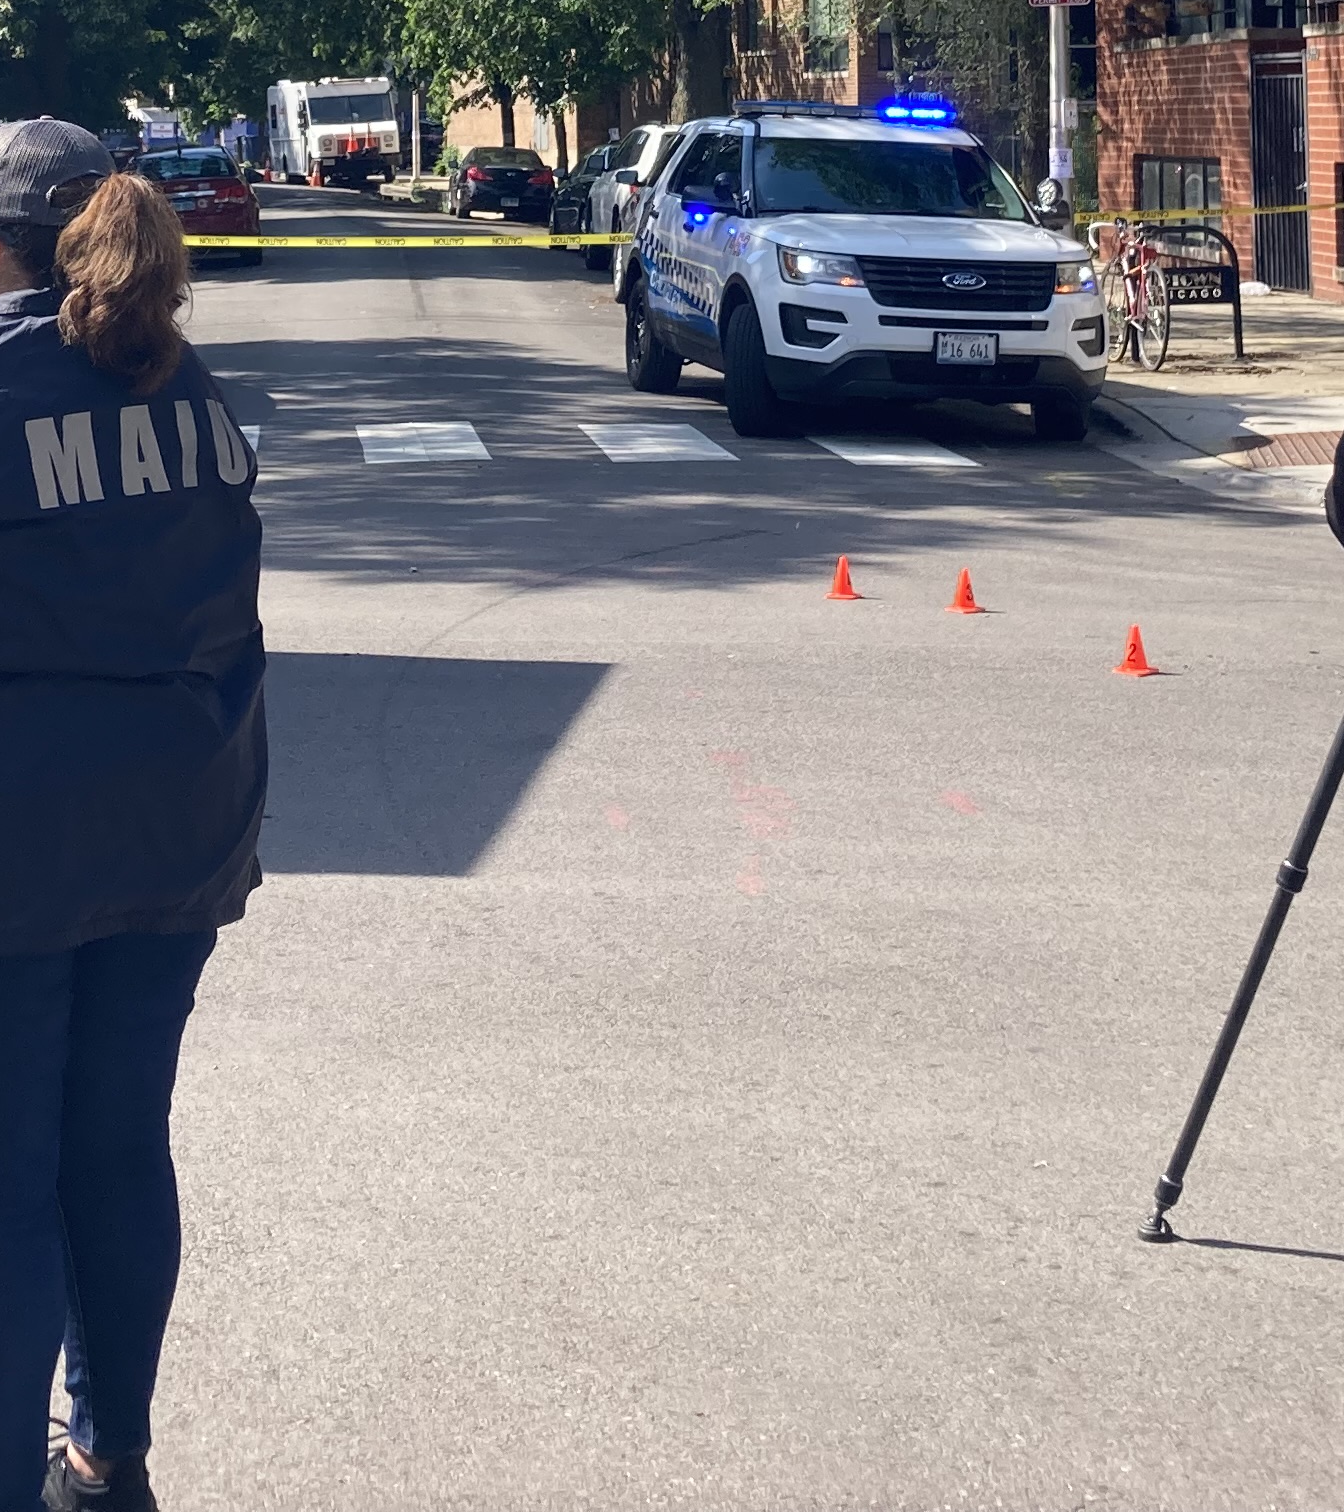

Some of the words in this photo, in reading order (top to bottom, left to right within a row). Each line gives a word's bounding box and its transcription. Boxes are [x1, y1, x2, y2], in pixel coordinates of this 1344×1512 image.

[199, 237, 230, 246] CAUTION
[258, 237, 288, 246] CAUTION
[316, 237, 347, 246] CAUTION
[375, 237, 406, 246] CAUTION
[434, 237, 464, 246] CAUTION
[492, 237, 523, 245] CAUTION
[551, 236, 581, 245] CAUTION
[953, 274, 977, 285] Ford
[970, 343, 989, 359] 641
[1127, 643, 1137, 663] 2
